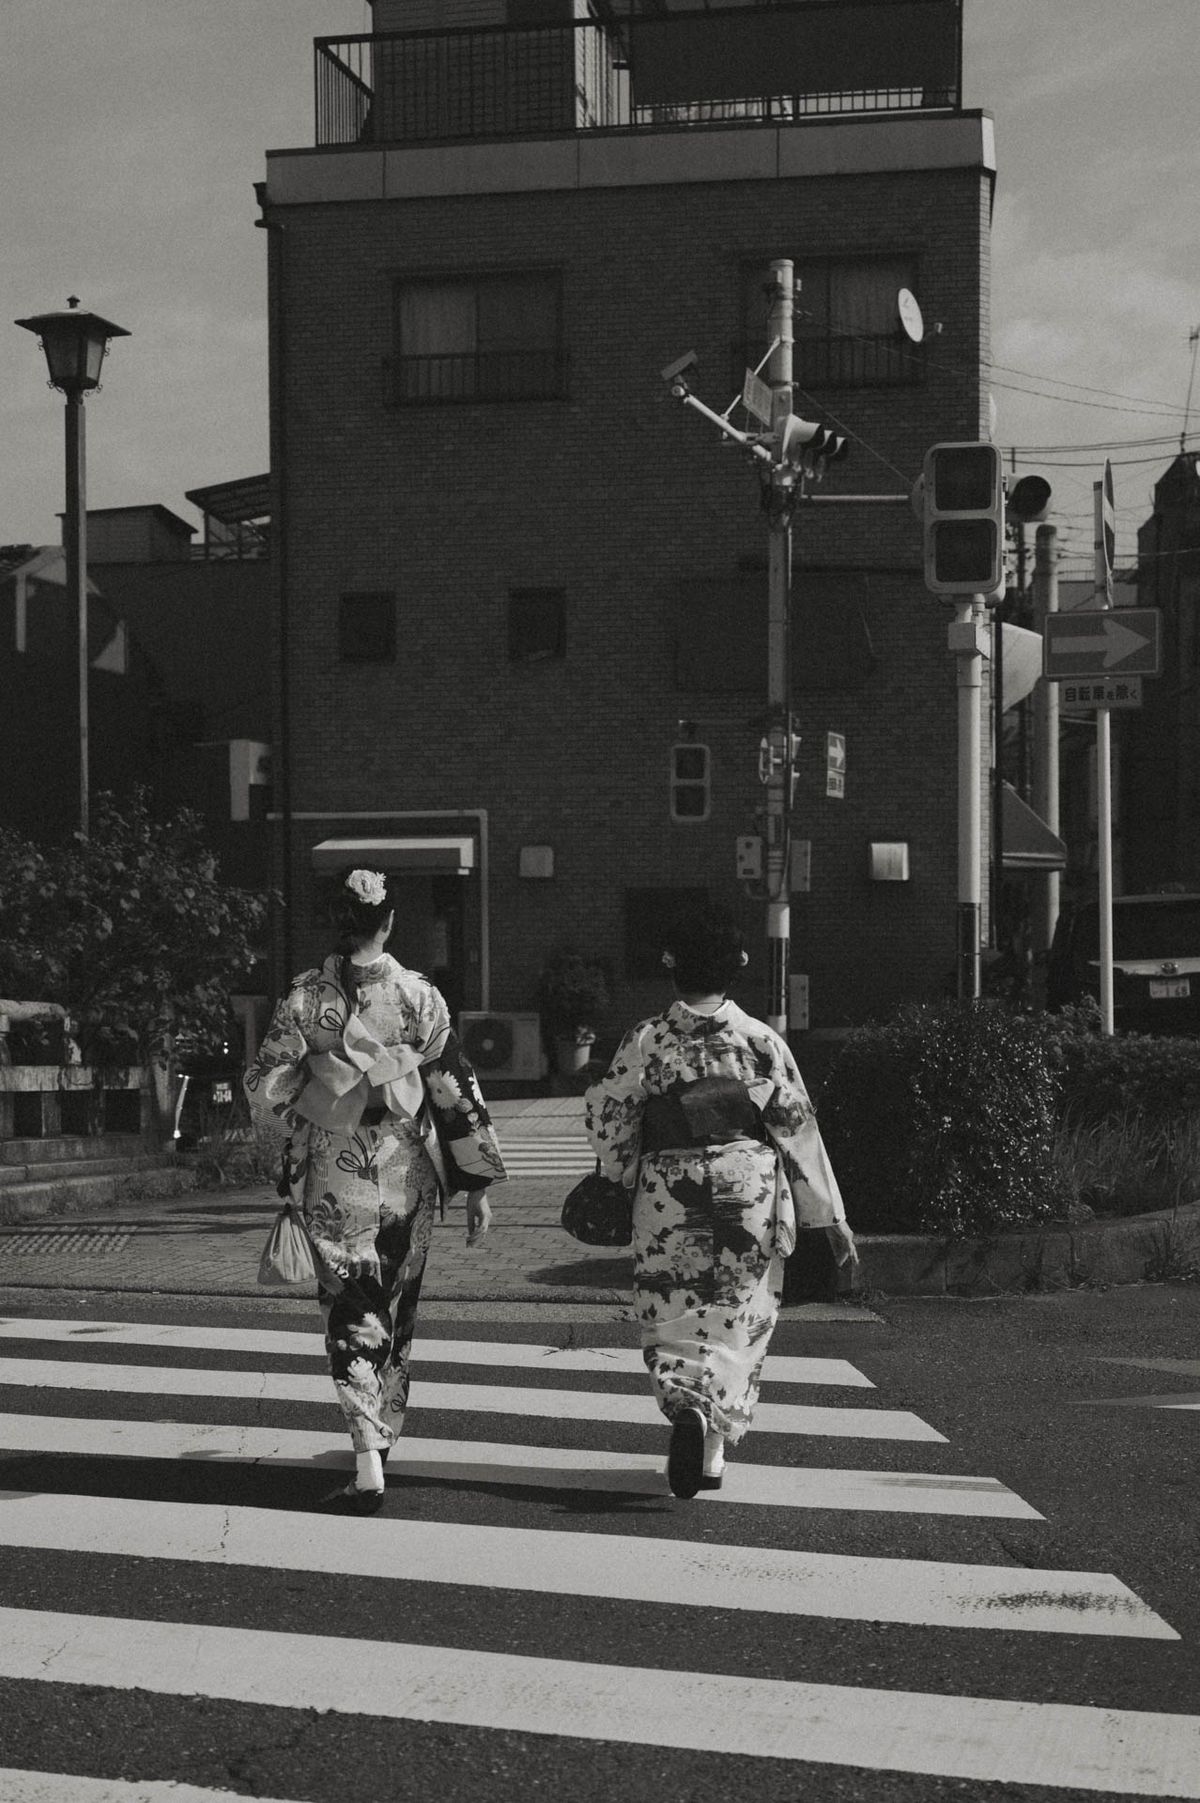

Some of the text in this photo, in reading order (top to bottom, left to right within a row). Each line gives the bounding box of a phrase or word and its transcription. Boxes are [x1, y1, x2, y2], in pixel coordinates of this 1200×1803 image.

[1065, 684, 1138, 702] 自転車を除く
